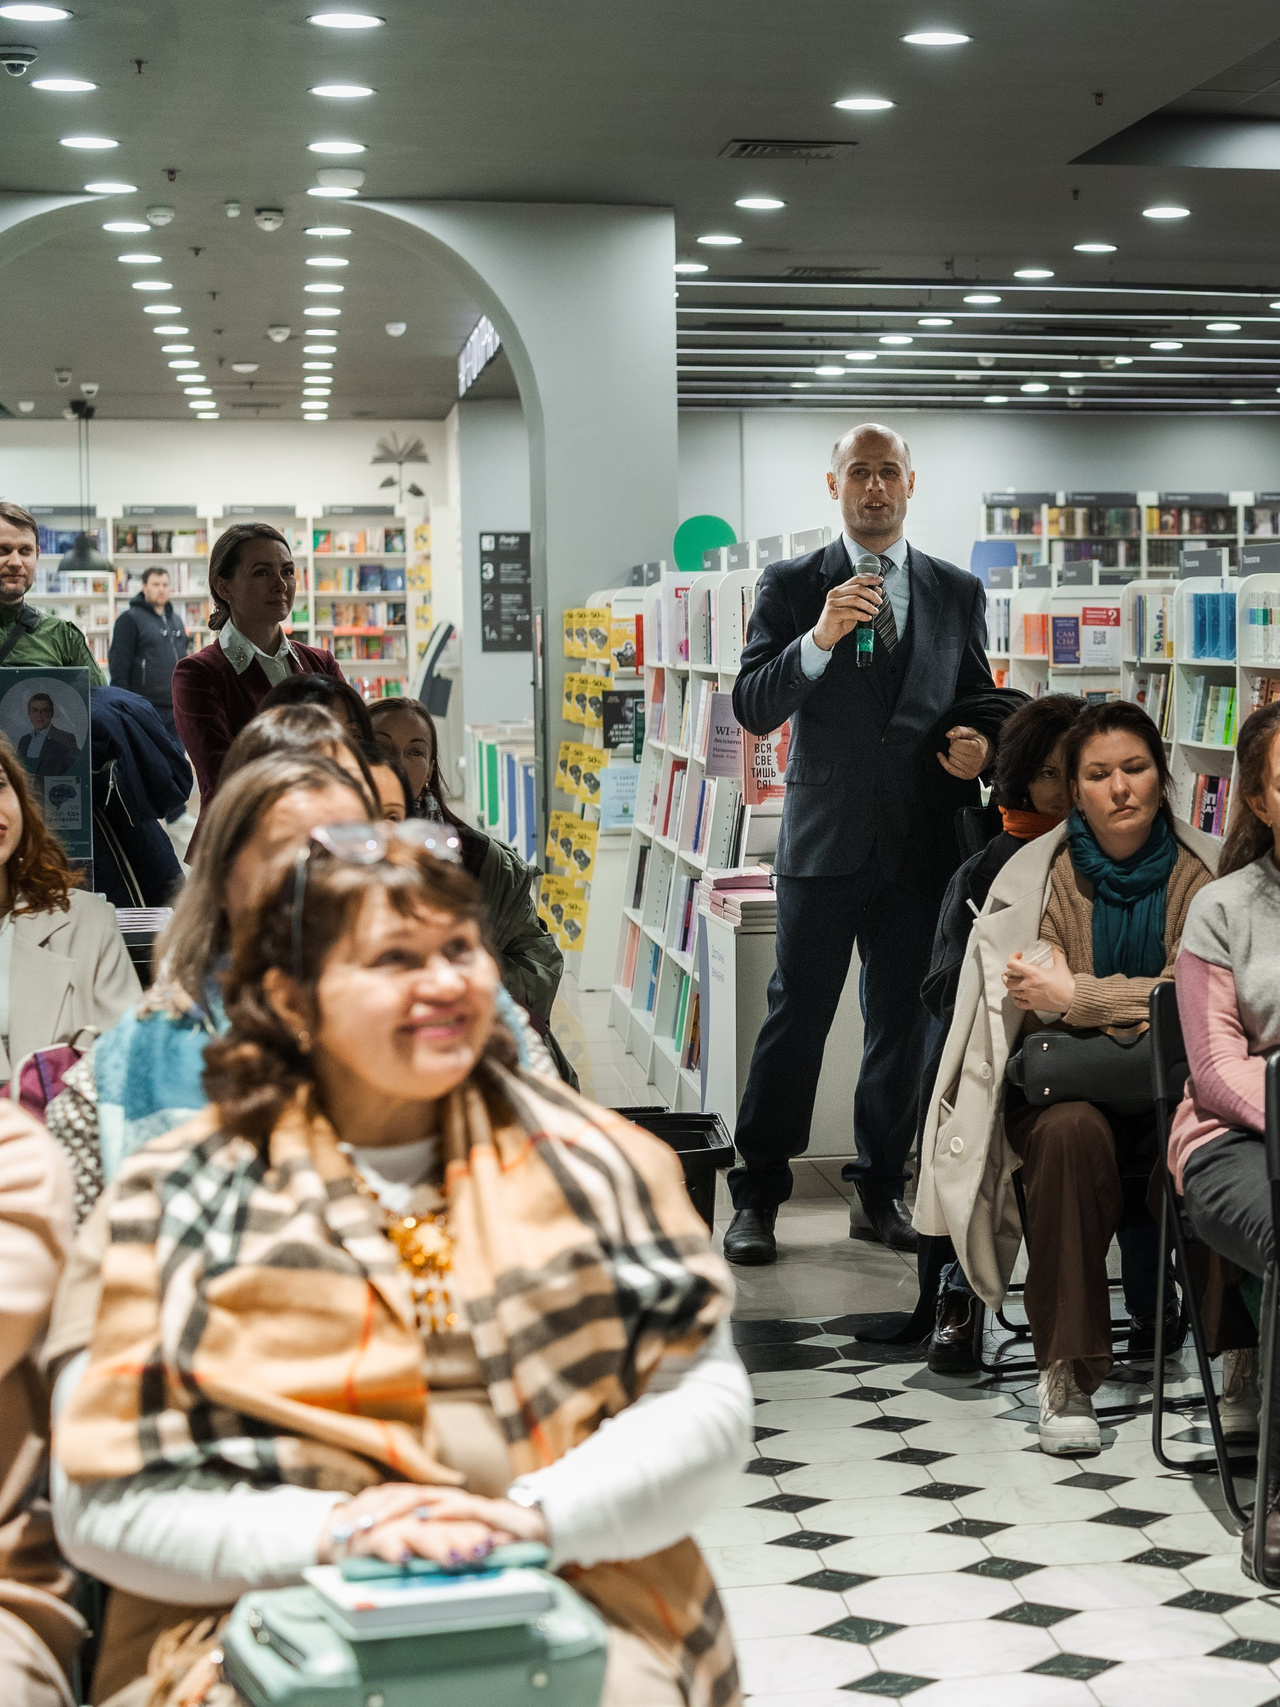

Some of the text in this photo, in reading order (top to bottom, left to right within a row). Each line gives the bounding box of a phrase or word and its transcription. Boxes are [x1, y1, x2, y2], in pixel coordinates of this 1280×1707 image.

[482, 562, 495, 580] 3
[483, 593, 495, 611] 2
[715, 726, 742, 736] WI-F
[713, 737, 742, 745] бесплатн
[754, 743, 772, 754] ВСЯ
[755, 755, 772, 766] СВЕ
[751, 767, 777, 778] ТИШЬ
[756, 780, 771, 790] СЯ!
